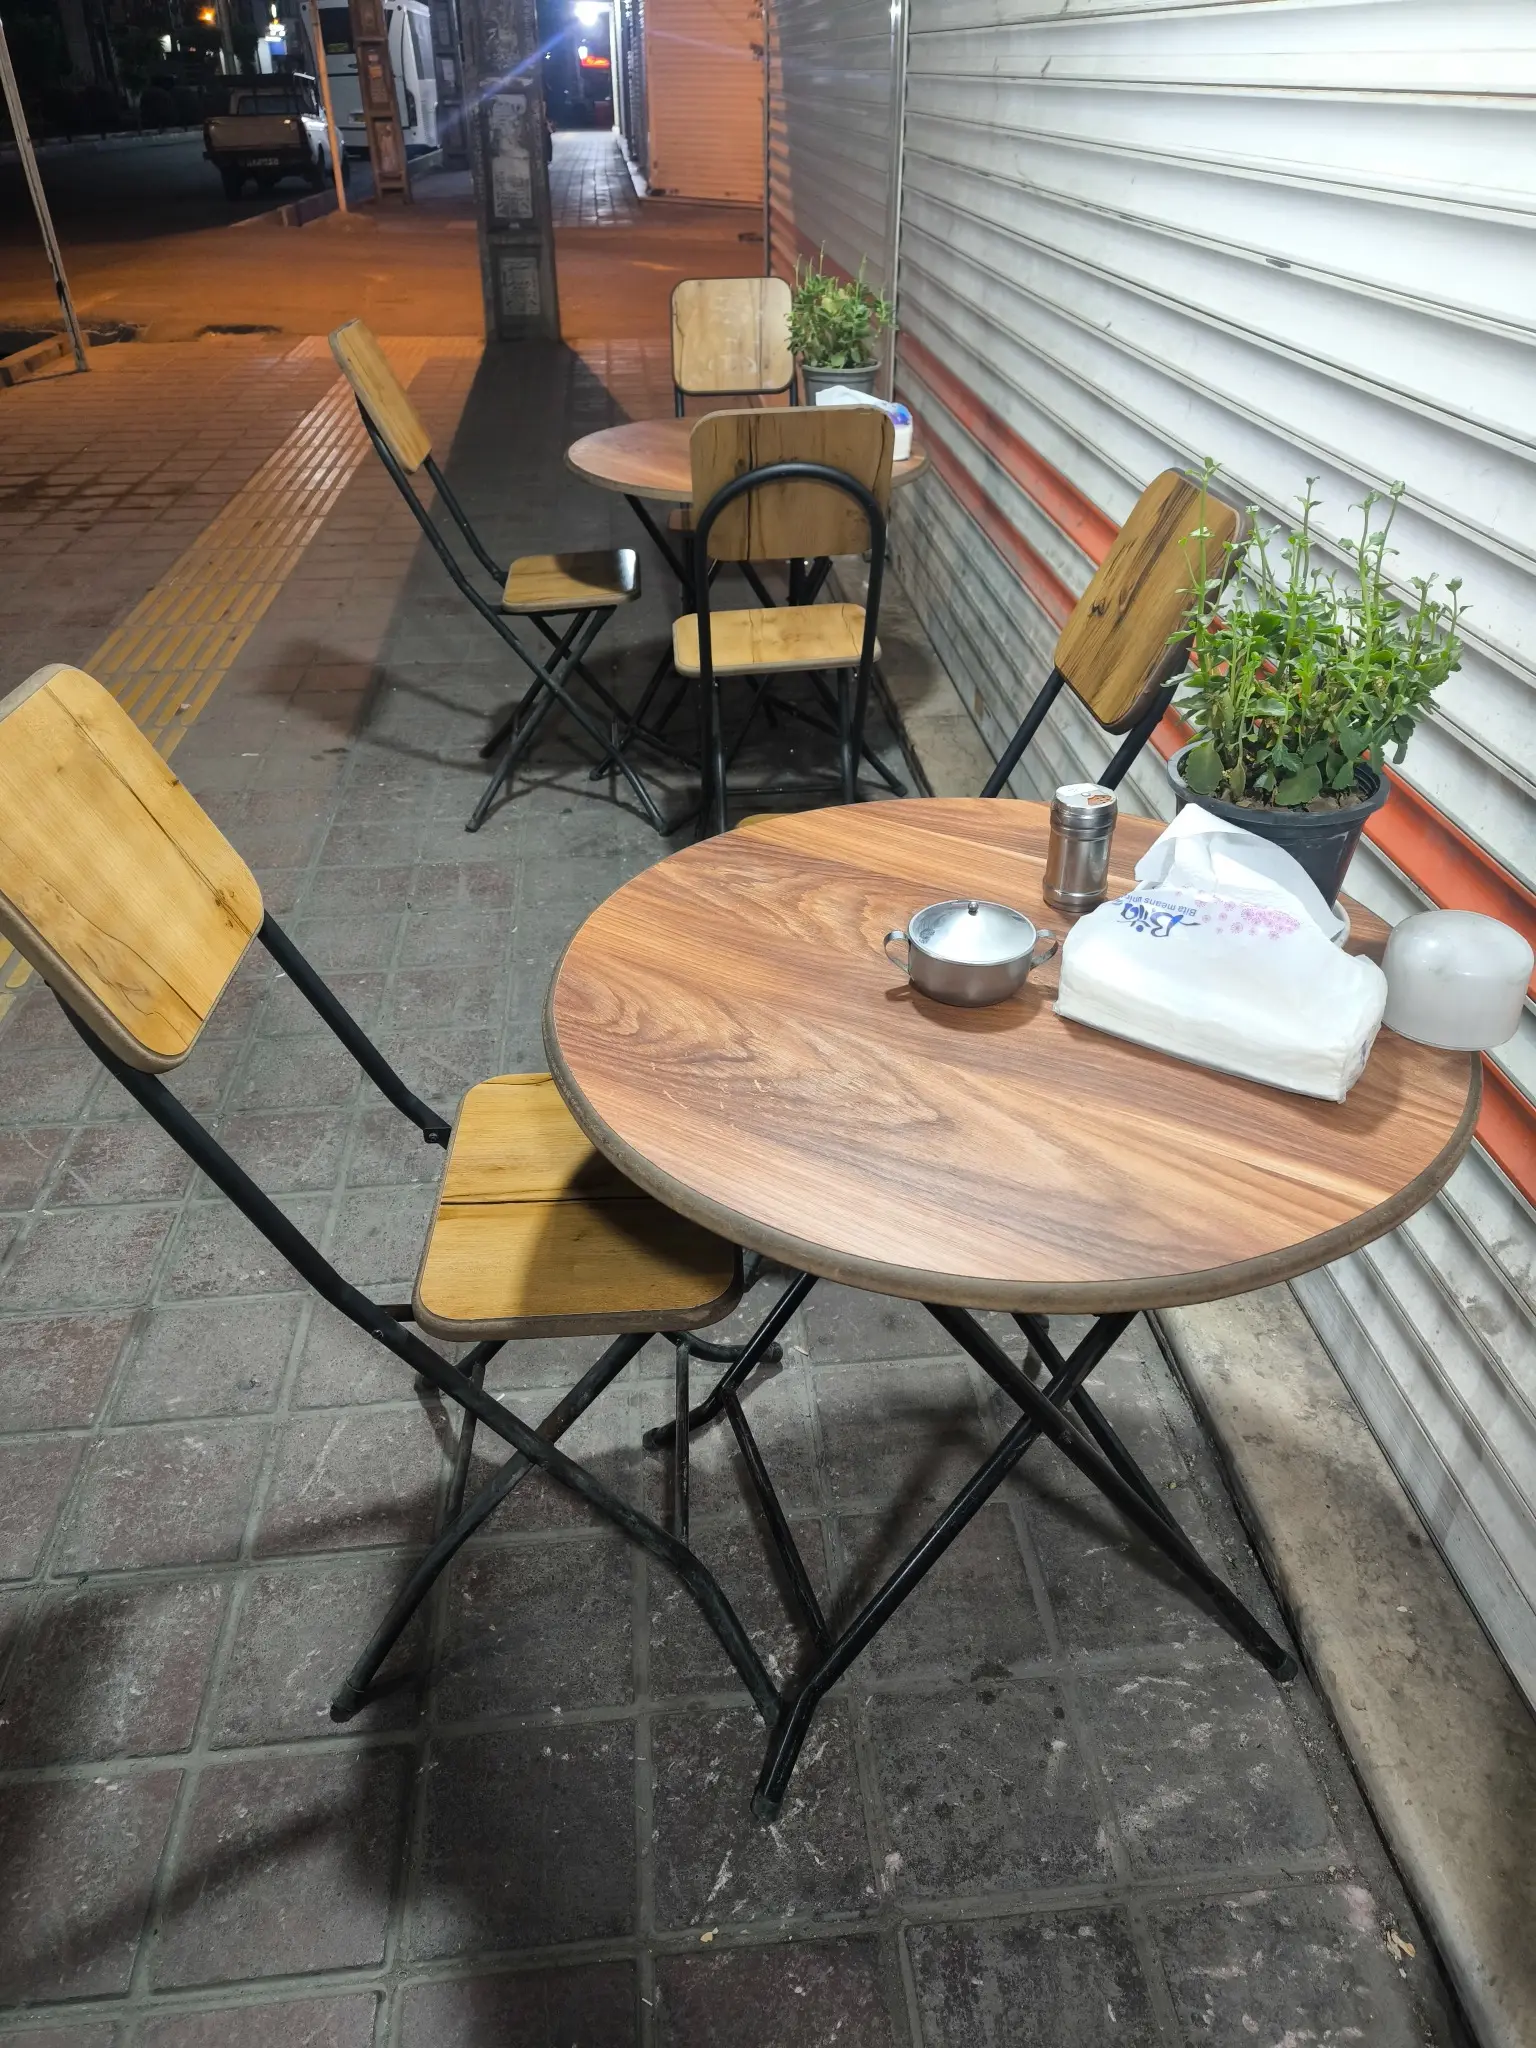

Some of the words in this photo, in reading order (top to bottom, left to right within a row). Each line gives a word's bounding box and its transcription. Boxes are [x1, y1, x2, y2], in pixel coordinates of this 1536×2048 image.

[1144, 897, 1176, 911] means
[1178, 905, 1197, 917] Bita
[1118, 903, 1200, 937] Bita
